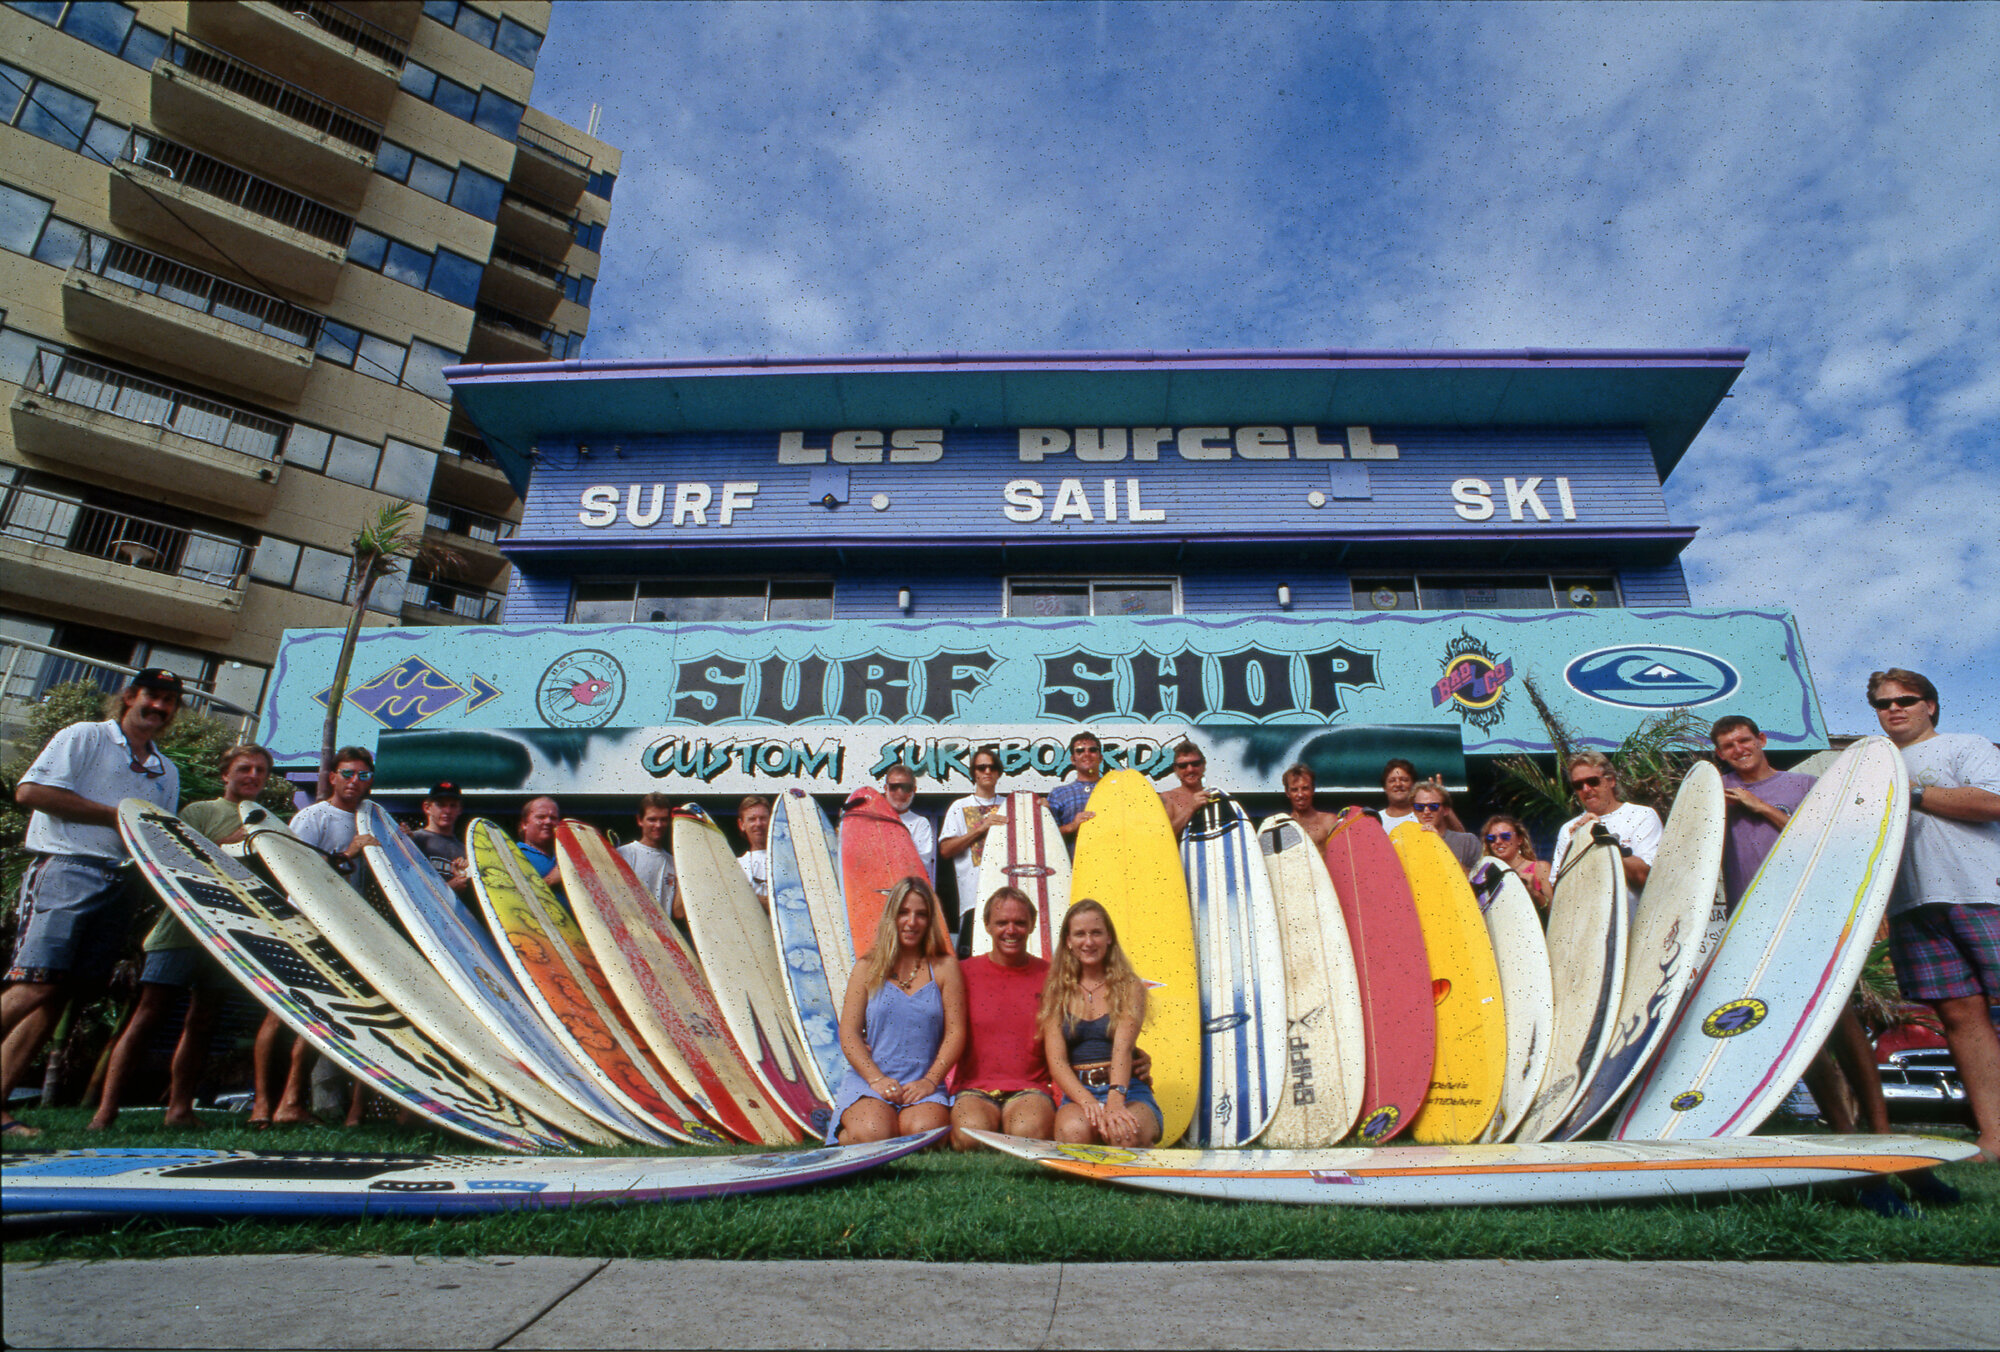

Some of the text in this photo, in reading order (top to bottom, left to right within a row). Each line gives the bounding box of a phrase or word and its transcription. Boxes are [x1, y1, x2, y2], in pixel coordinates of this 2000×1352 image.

[578, 476, 1577, 528] SURF SAIL SKI
[671, 643, 1381, 725] SURF SHOP
[641, 735, 846, 784] CUSTOM
